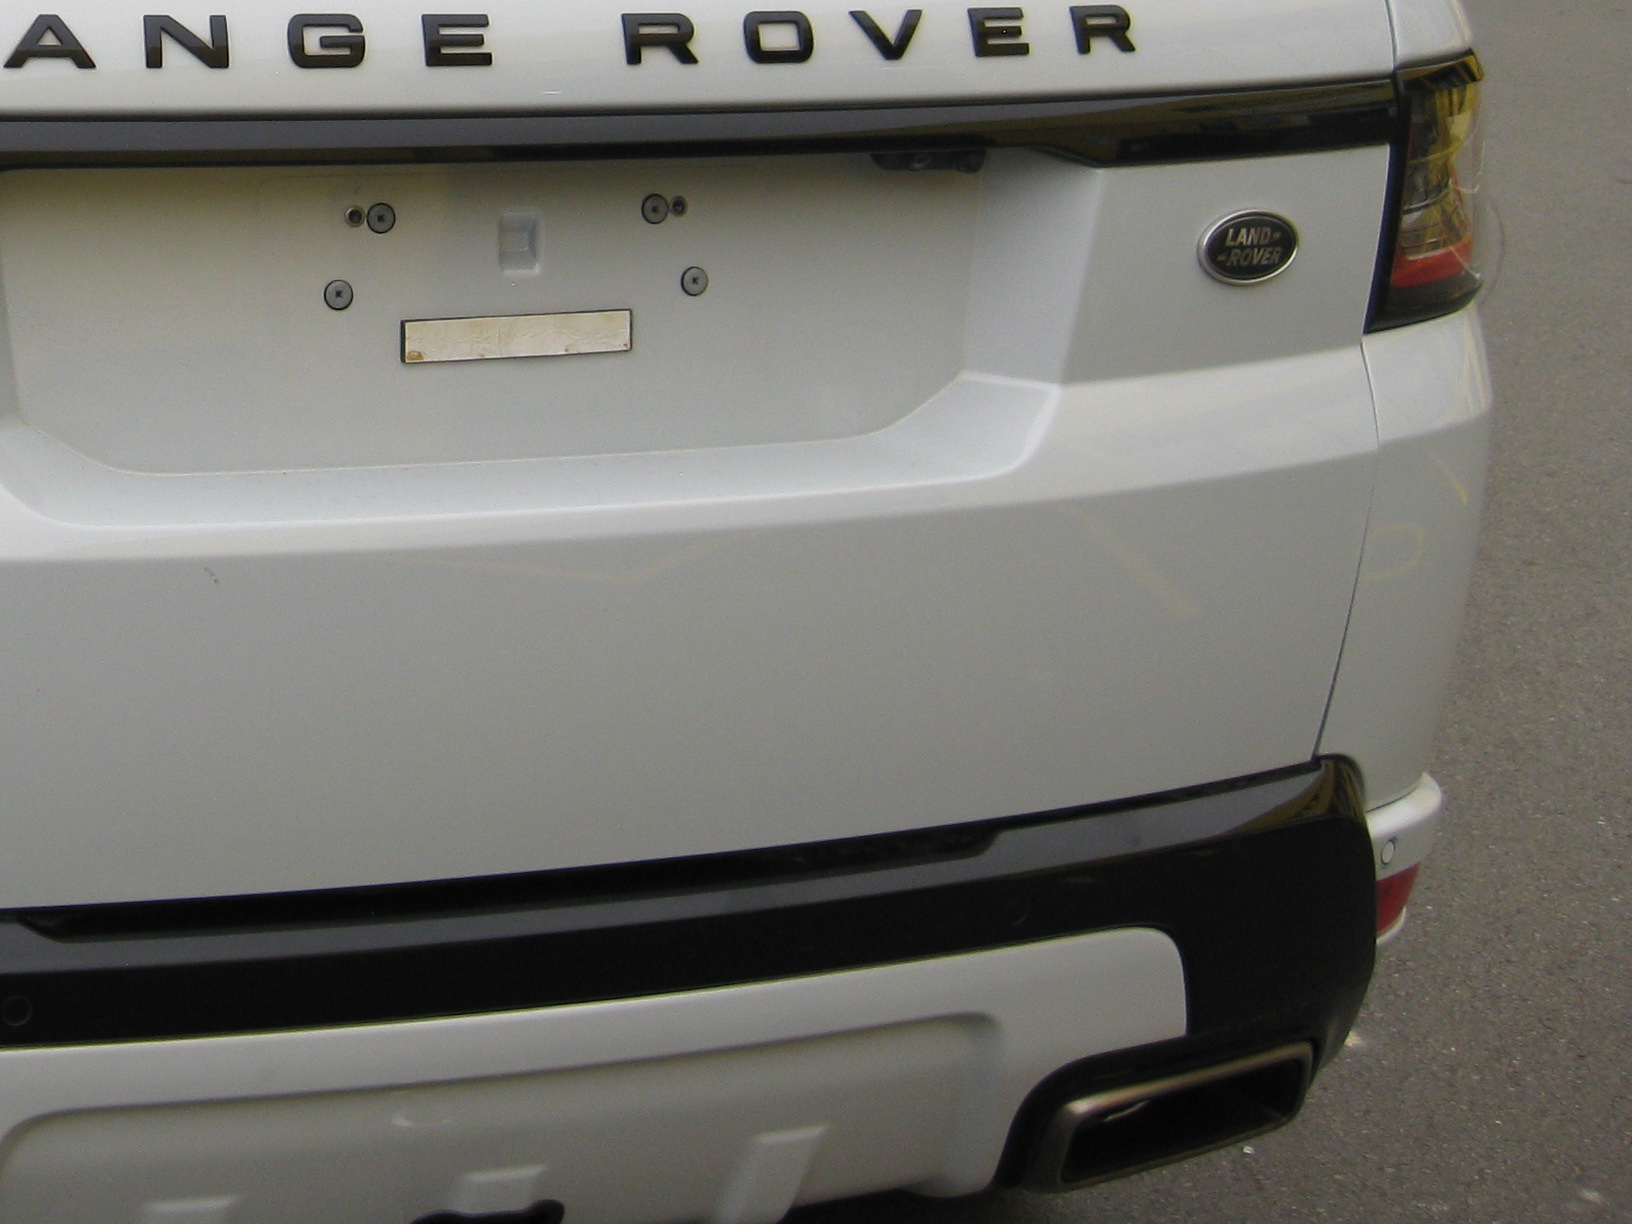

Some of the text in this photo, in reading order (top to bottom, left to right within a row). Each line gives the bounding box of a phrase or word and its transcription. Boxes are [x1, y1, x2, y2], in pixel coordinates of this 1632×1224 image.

[622, 4, 1137, 65] ROVER
[1225, 227, 1272, 246] LAND
[1227, 247, 1283, 266] ROVER
